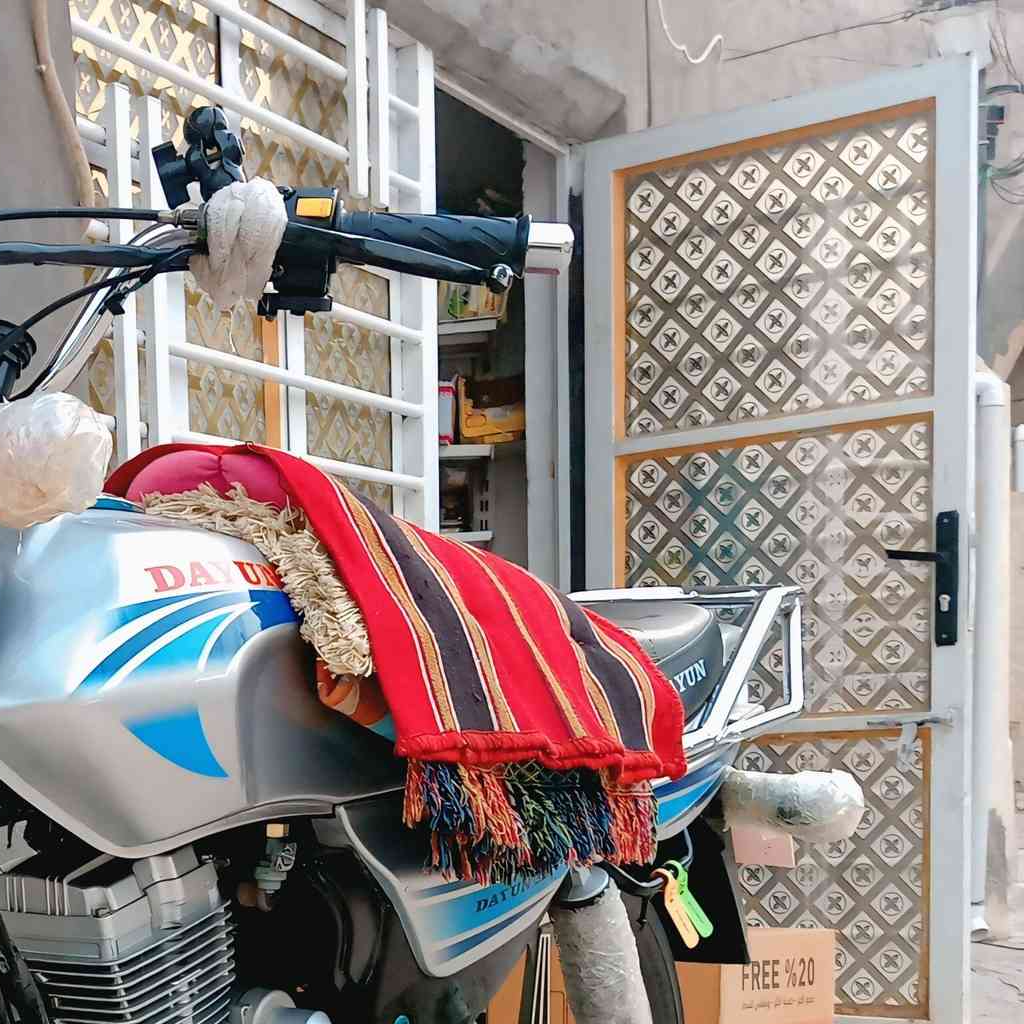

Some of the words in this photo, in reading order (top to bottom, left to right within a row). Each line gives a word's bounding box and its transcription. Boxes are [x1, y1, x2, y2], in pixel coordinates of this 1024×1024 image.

[668, 658, 707, 694] YUN
[741, 959, 780, 991] FREE
[784, 956, 816, 988] %20
